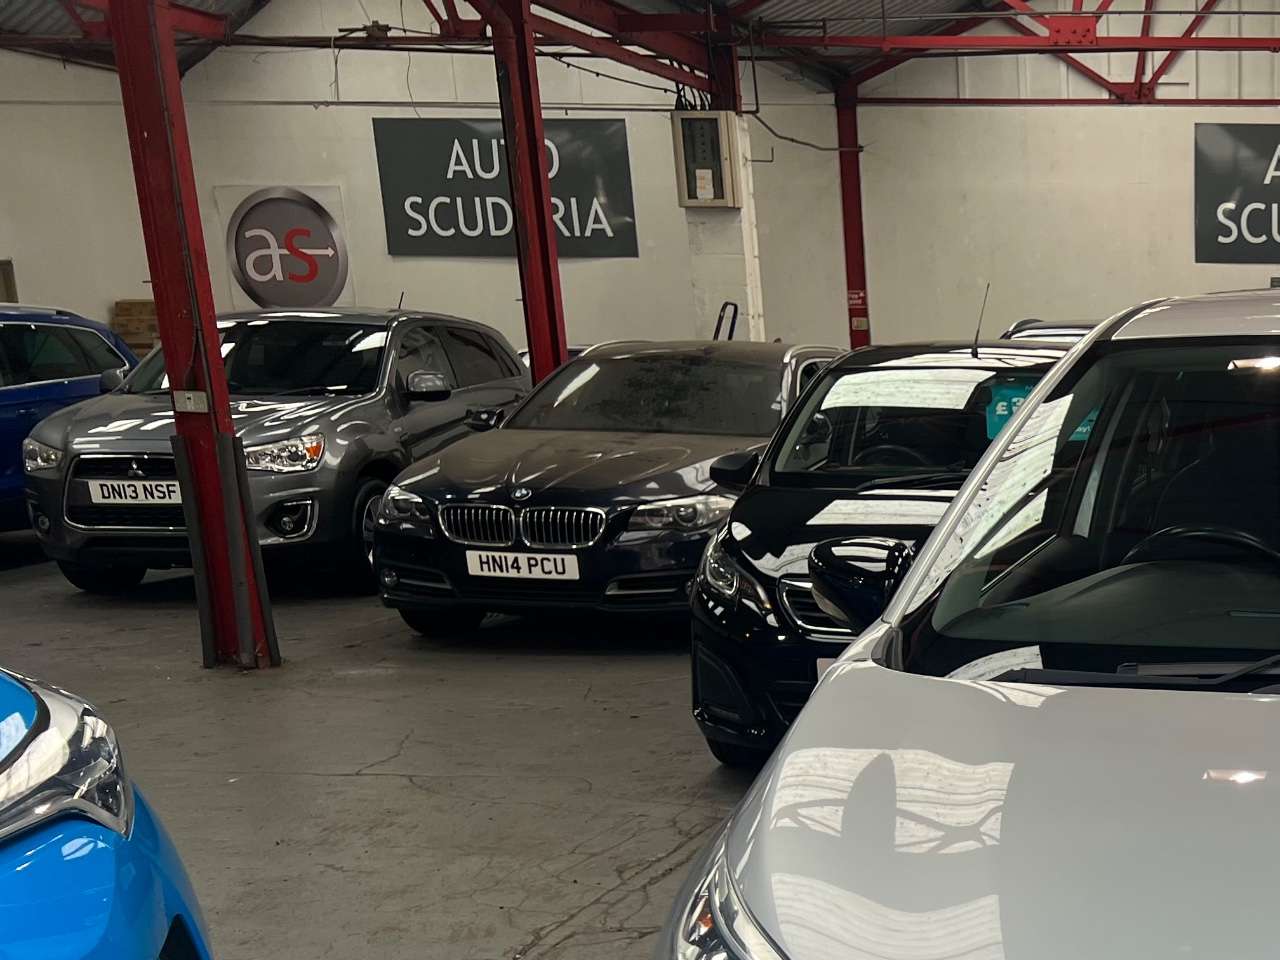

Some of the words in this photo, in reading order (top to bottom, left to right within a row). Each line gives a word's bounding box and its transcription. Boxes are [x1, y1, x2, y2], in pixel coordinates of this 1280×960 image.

[404, 196, 614, 237] SCUDRIA
[244, 227, 319, 284] as
[99, 483, 139, 500] DN13
[142, 483, 177, 500] NSF
[478, 554, 522, 574] HN14
[526, 556, 566, 575] PCU
